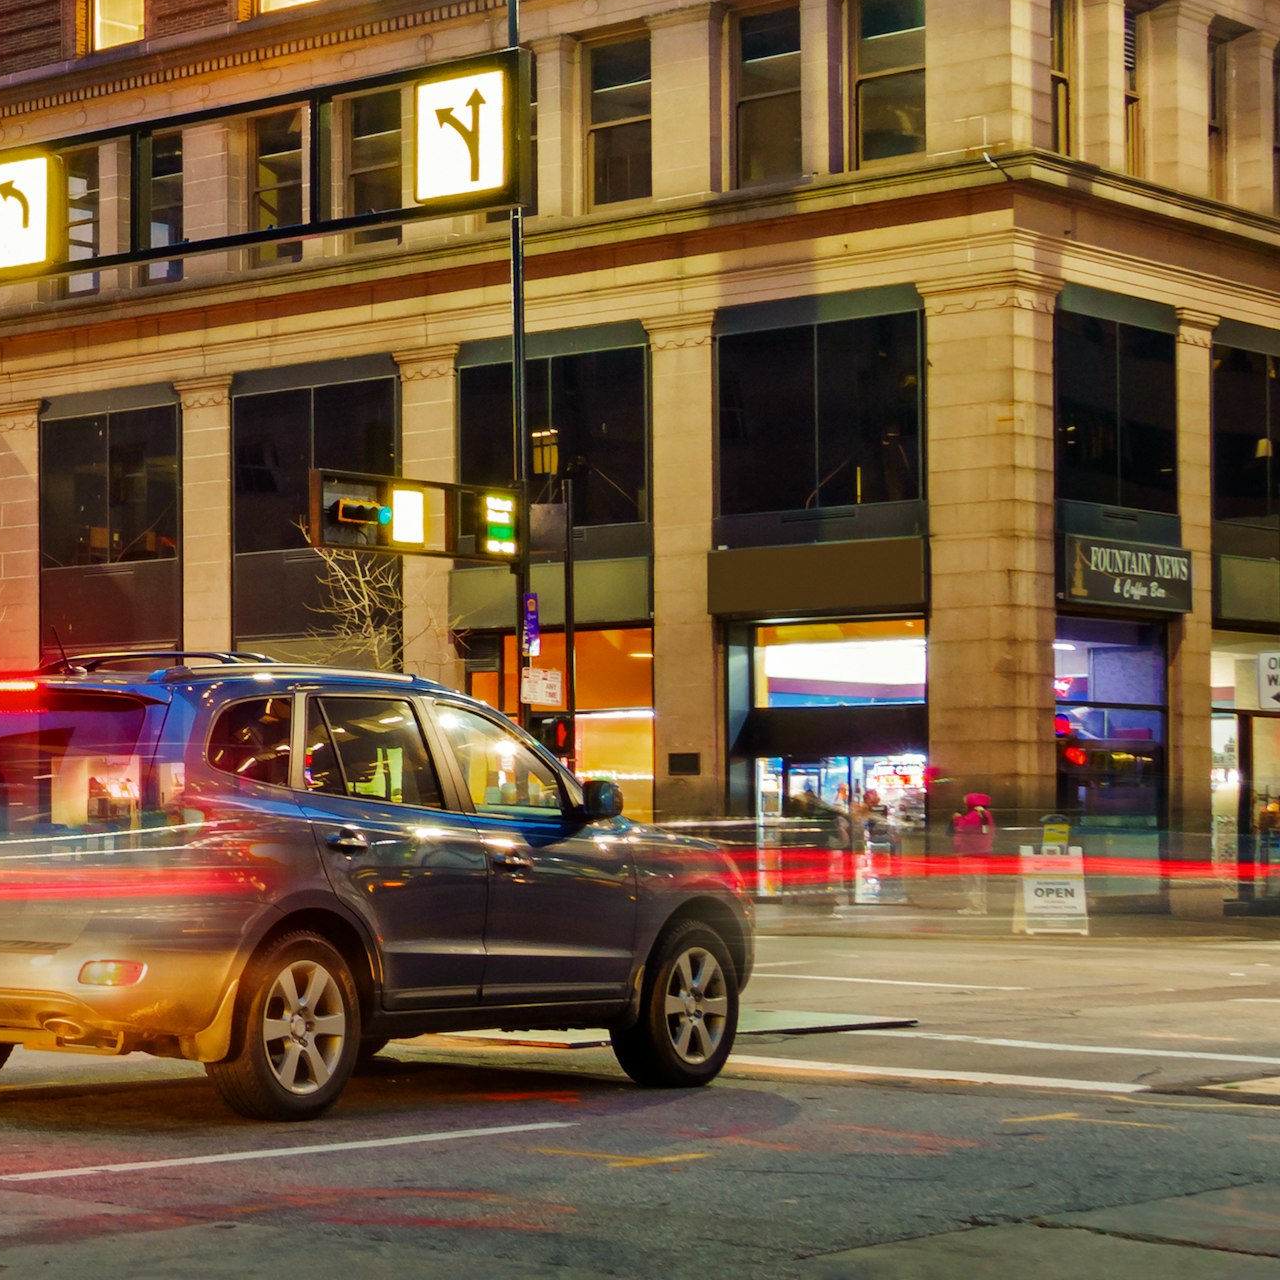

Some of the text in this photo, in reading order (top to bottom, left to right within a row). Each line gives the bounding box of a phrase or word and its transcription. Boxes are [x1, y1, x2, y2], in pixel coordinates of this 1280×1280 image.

[1090, 546, 1188, 581] FOUNTAIN NEWS
[1034, 887, 1075, 898] OPEN
